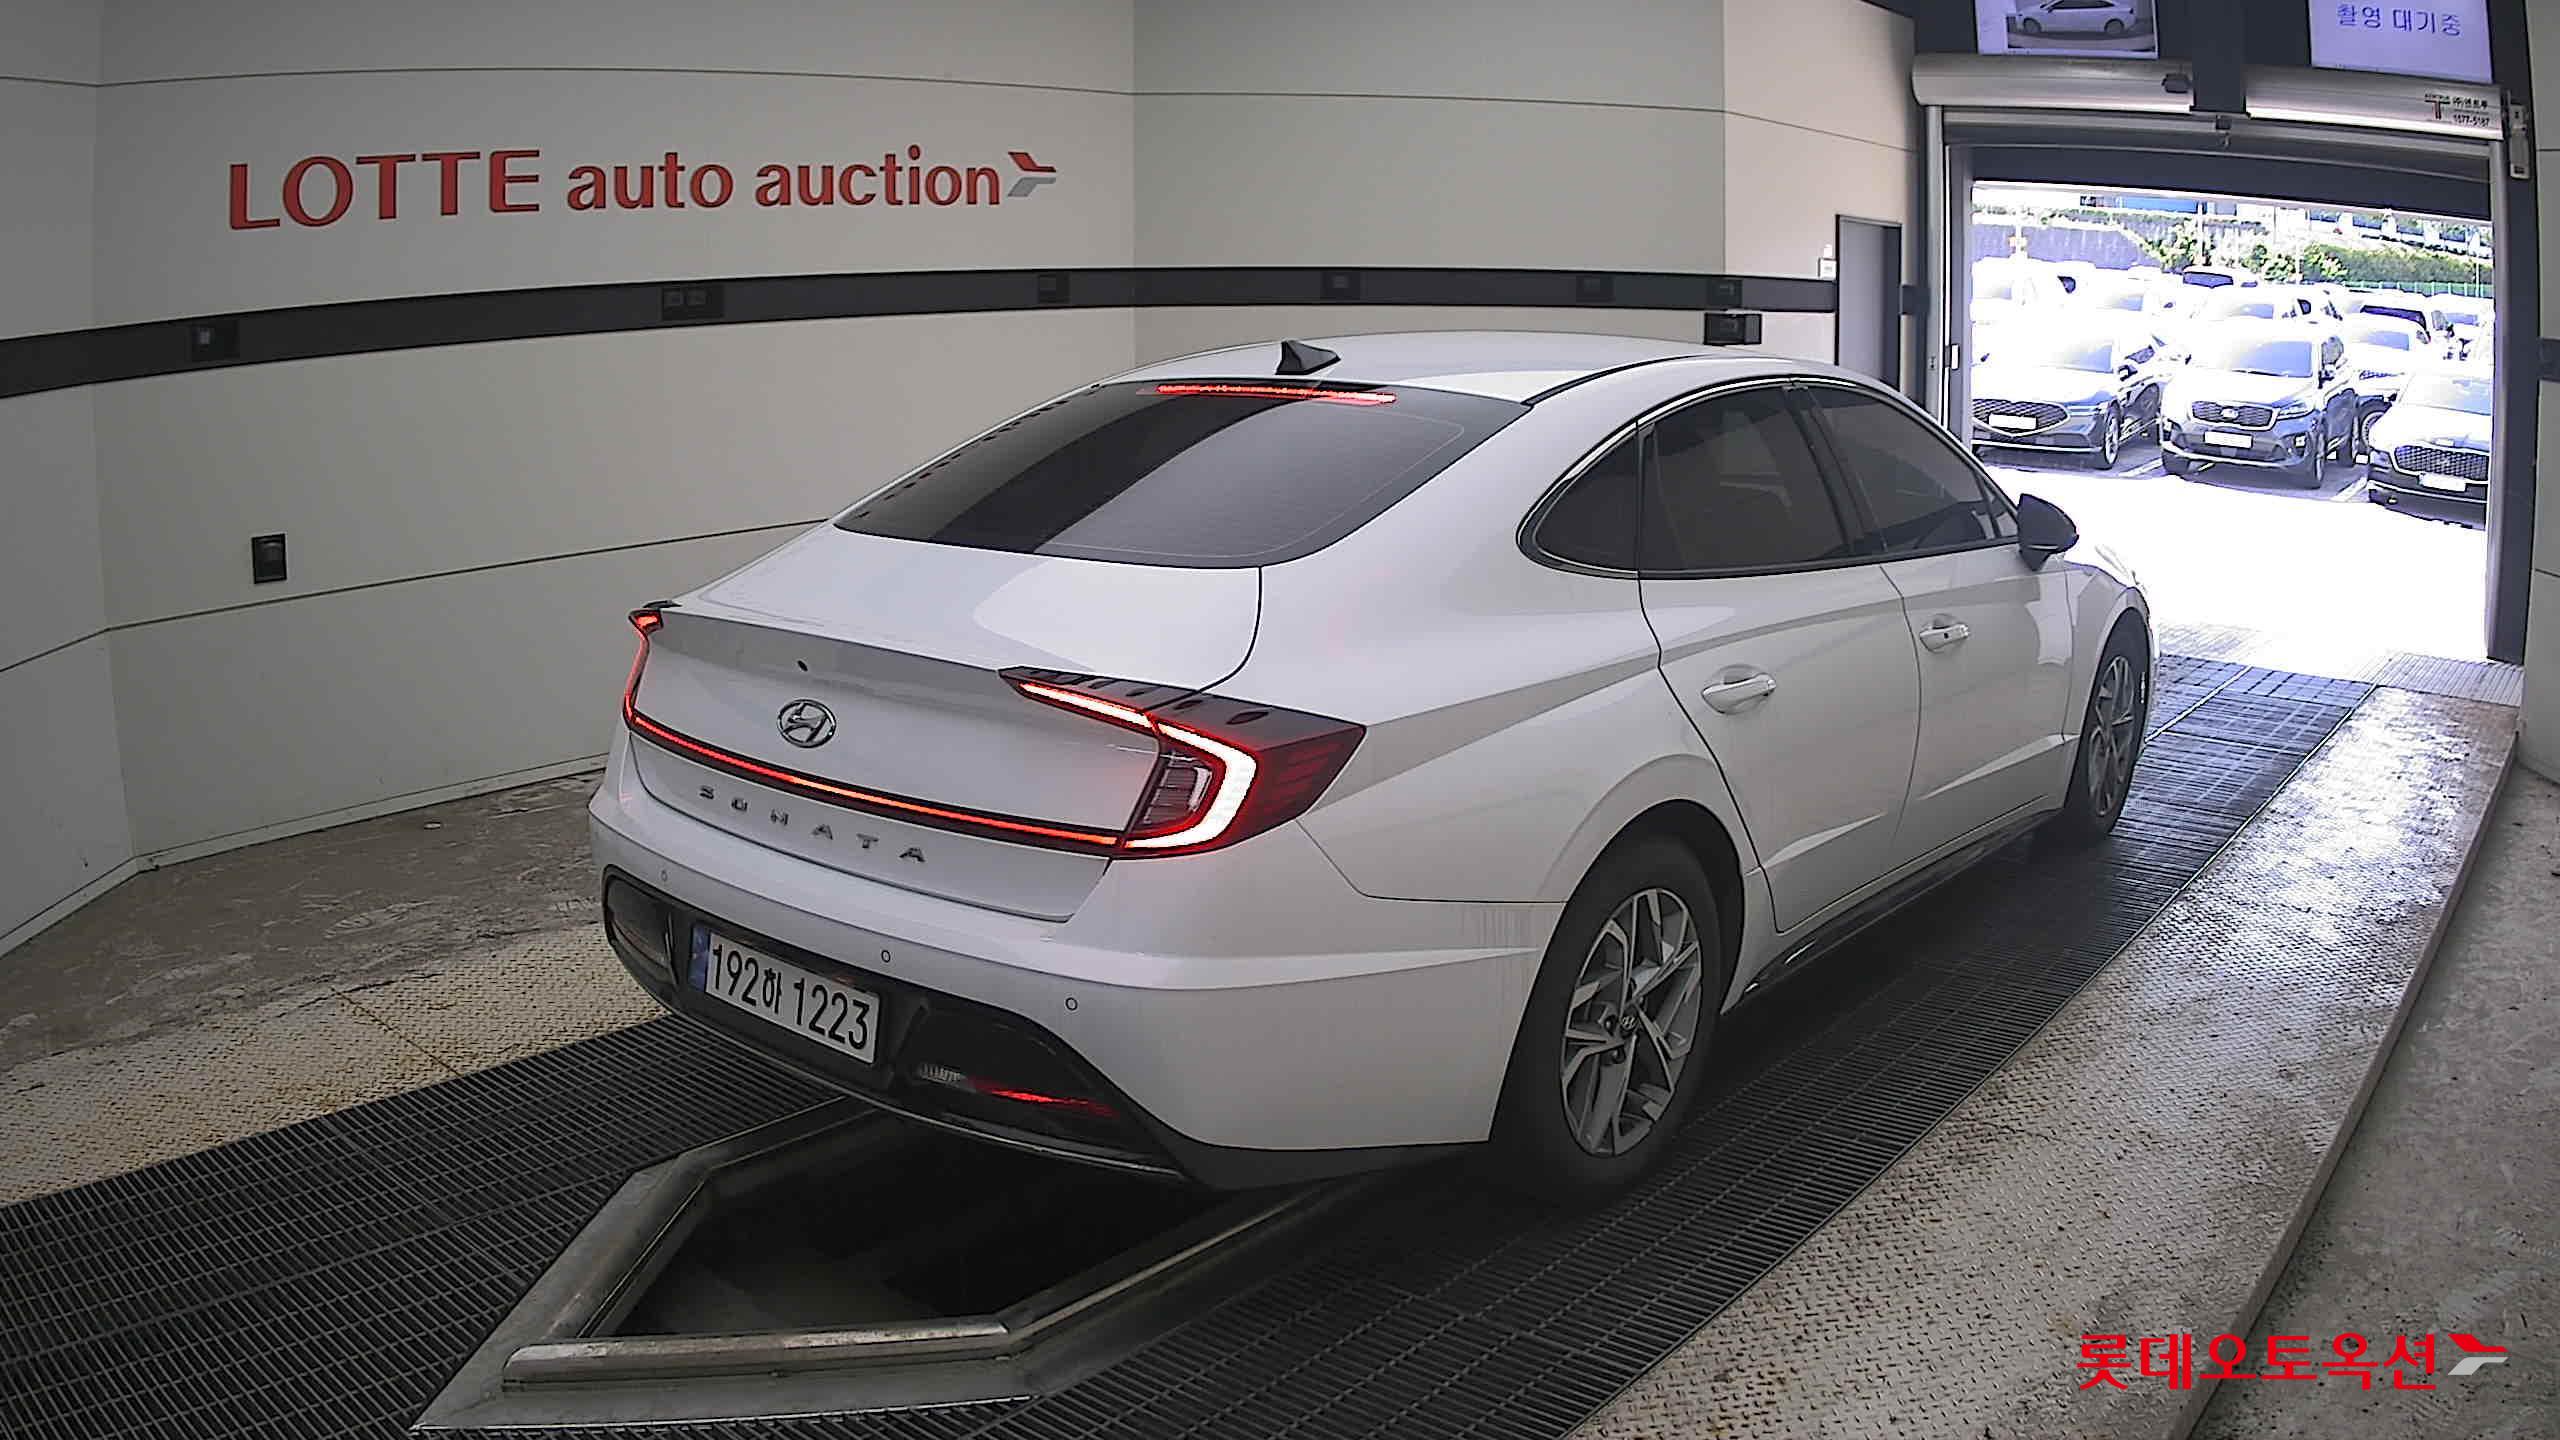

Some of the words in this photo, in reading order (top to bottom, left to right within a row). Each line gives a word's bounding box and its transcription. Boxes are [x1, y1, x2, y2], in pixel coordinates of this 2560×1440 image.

[2337, 4, 2382, 29] 촬영
[229, 149, 541, 231] LOTTE
[566, 150, 734, 210] auto
[754, 145, 1001, 208] auction
[699, 784, 926, 863] SONATA
[712, 943, 783, 1016] 192하
[793, 976, 872, 1050] 1223
